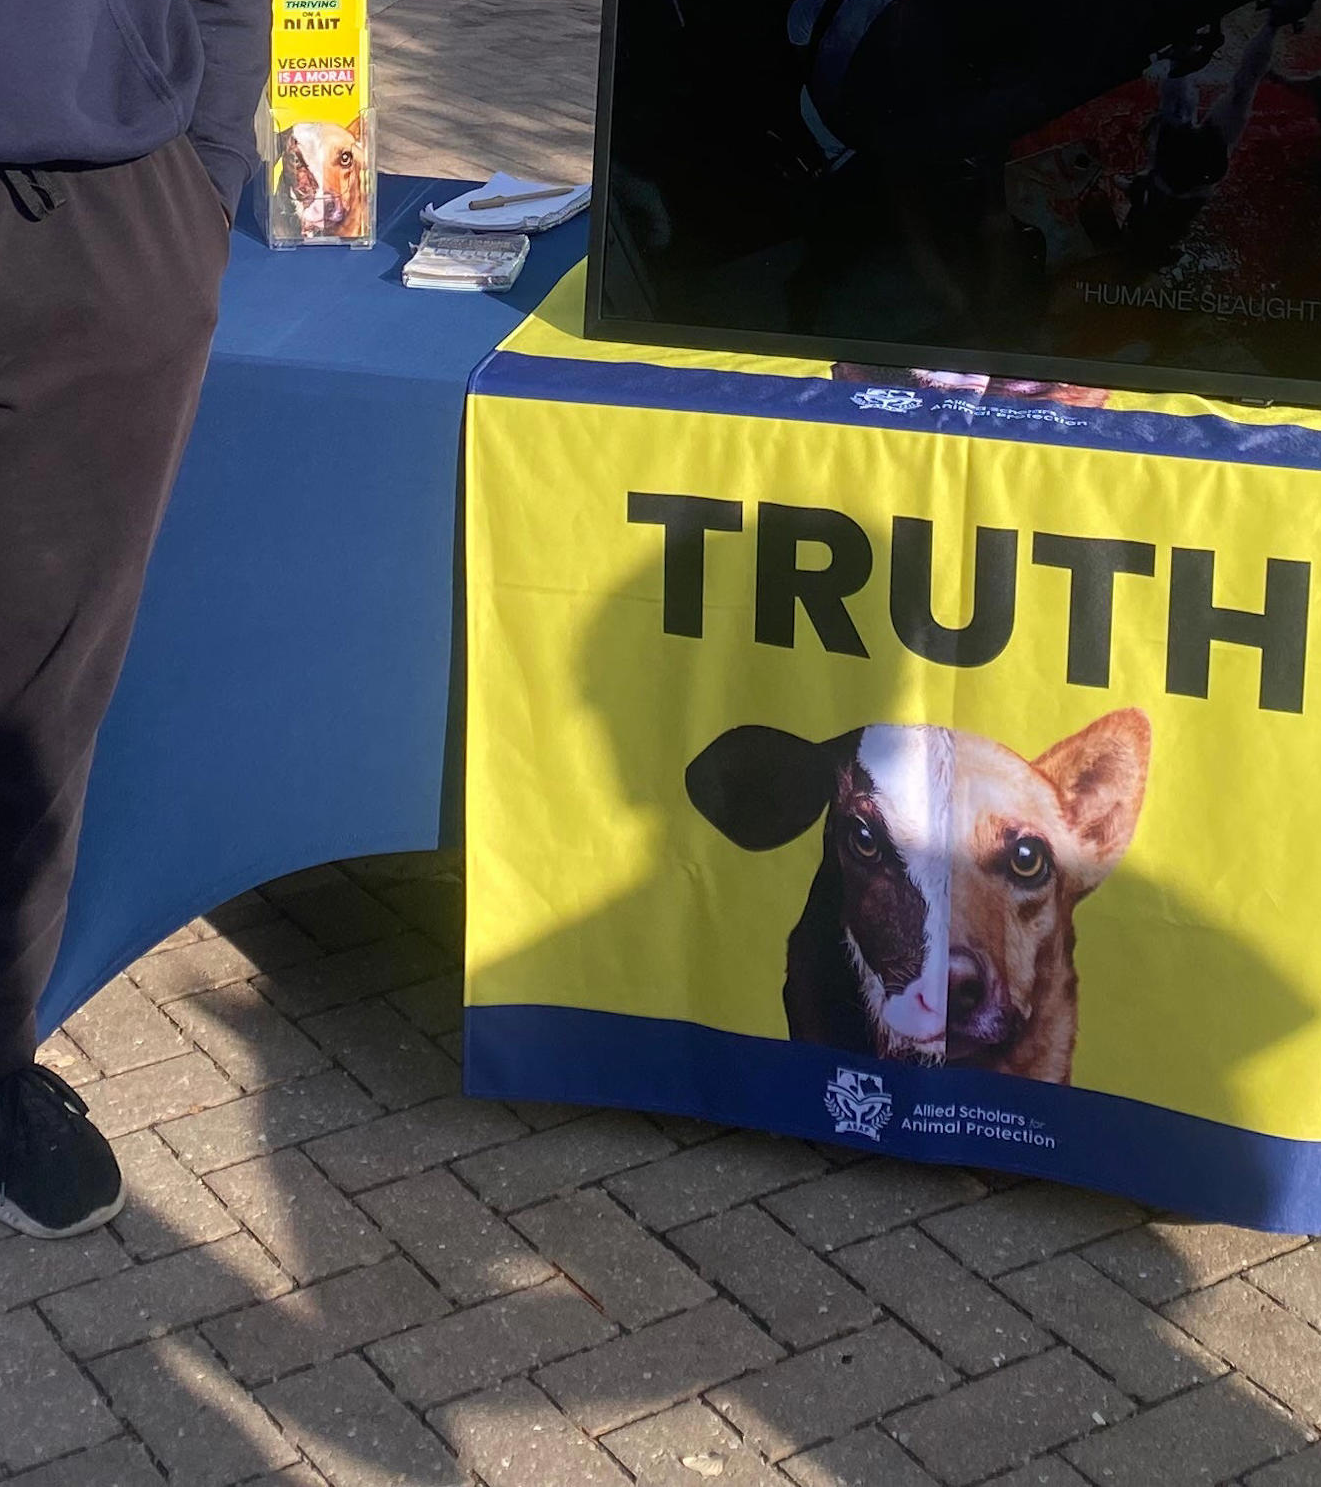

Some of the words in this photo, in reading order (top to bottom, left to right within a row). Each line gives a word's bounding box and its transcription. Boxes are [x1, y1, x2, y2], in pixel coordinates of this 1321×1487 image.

[285, 0, 338, 10] THRIVING
[277, 56, 356, 70] VEGANISM
[278, 71, 291, 83] IS
[292, 71, 304, 83] A
[305, 70, 354, 83] MORAL
[277, 83, 356, 98] URGENCY
[1076, 281, 1200, 312] "HUMANE
[626, 490, 1311, 716] TRUTH
[912, 1103, 956, 1118] Allied
[959, 1105, 1026, 1127] Scholars
[900, 1117, 961, 1134] Animal
[966, 1122, 1056, 1149] Protection
